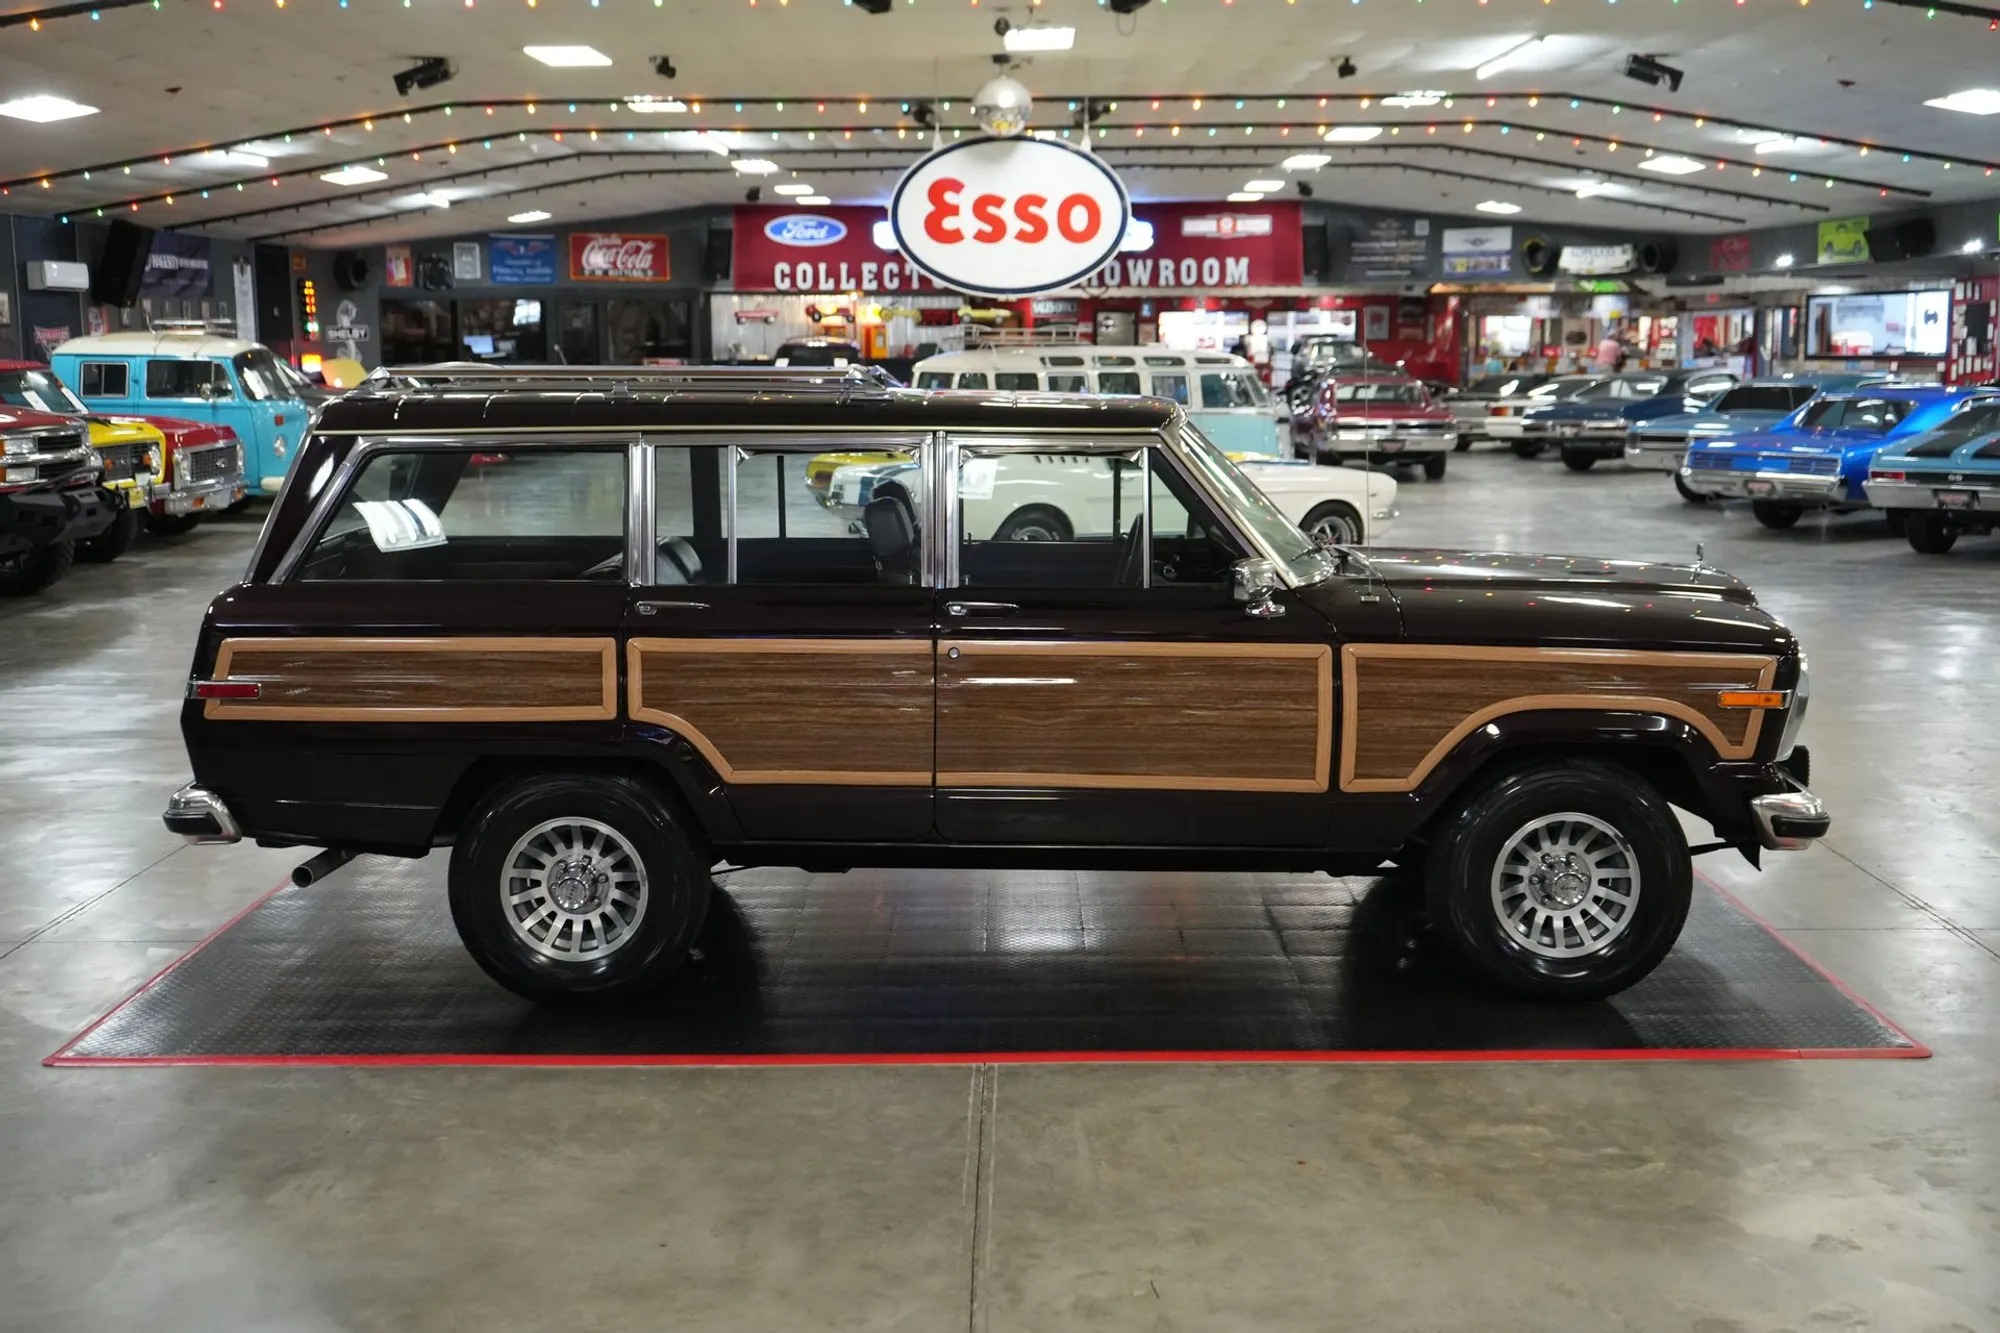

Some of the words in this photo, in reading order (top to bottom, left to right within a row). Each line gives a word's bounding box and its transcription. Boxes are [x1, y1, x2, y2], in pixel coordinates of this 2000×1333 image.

[924, 177, 1101, 244] Esso
[781, 219, 829, 240] Ford
[773, 261, 946, 291] COLLECT
